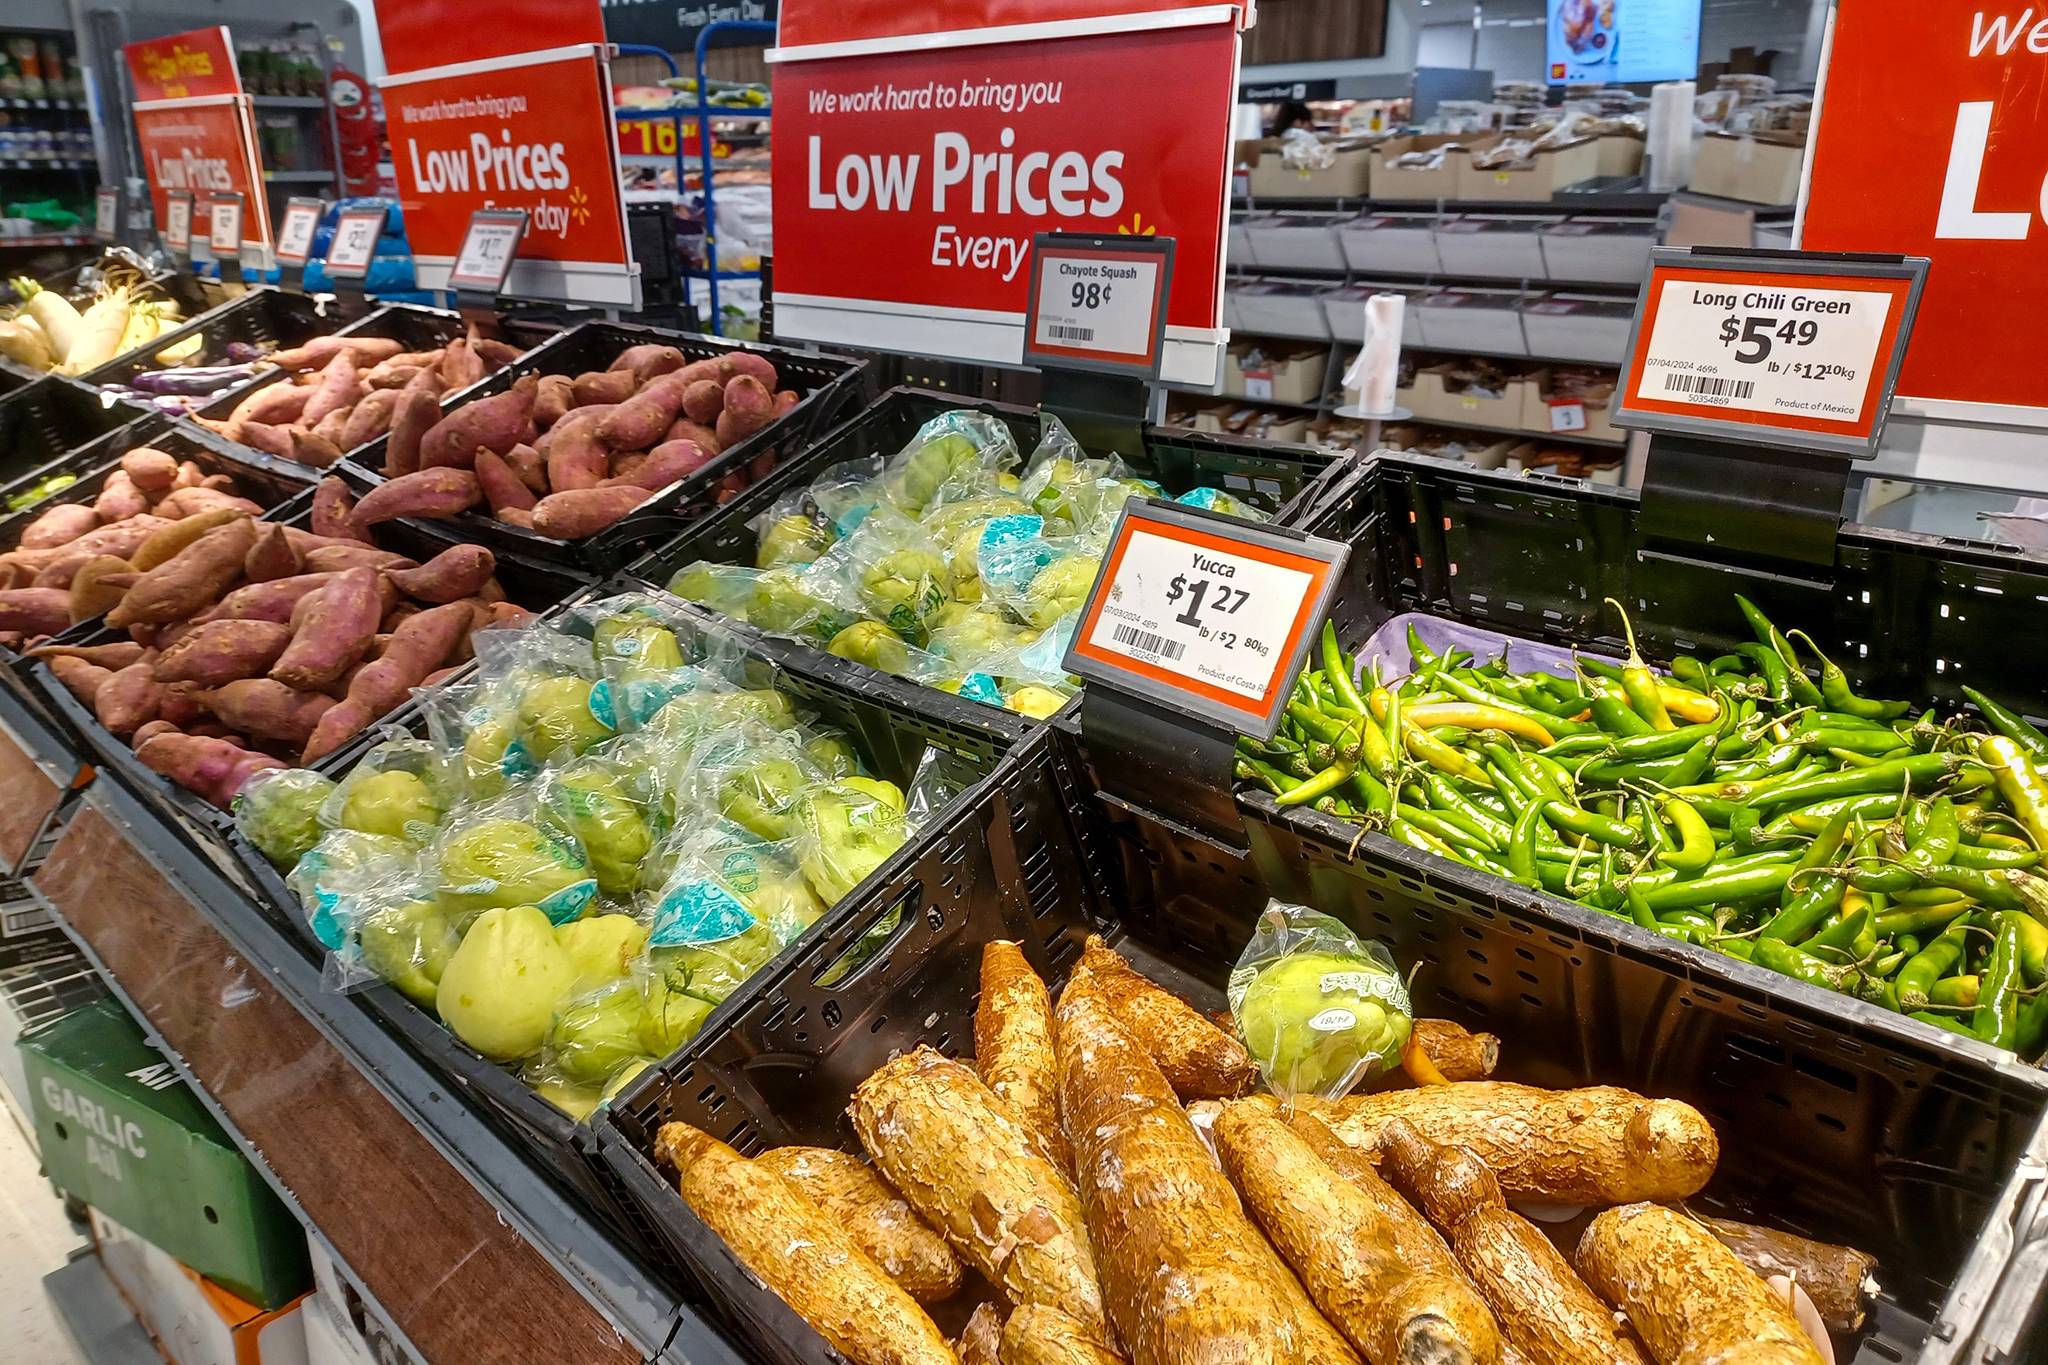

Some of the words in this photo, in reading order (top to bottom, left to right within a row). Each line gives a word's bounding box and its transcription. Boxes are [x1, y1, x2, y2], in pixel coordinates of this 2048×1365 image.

[504, 96, 527, 119] you
[808, 90, 836, 113] We
[839, 89, 883, 112] work
[885, 81, 933, 111] hard
[935, 85, 956, 109] to
[959, 77, 1015, 112] bring
[1016, 80, 1062, 112] you
[408, 138, 469, 193] Low
[470, 128, 570, 191] Prices
[808, 135, 920, 211] Low
[932, 127, 1125, 217] Prices
[534, 198, 569, 239] day
[931, 225, 1029, 282] Every
[1060, 263, 1098, 278] Chayote
[1100, 266, 1137, 280] Squash
[1071, 281, 1112, 309] 98¢
[1692, 290, 1737, 310] Long
[1742, 292, 1786, 311] Chili
[1791, 296, 1851, 315] Green
[1647, 357, 1695, 370] 07/04/2024
[1696, 364, 1718, 375] 4696
[1767, 361, 1780, 374] lb
[1688, 393, 1730, 406] 50354869
[1775, 397, 1809, 411] Product
[1811, 400, 1822, 411] of
[1822, 402, 1855, 415] Mexico
[1192, 553, 1236, 579] Yucca
[1199, 625, 1210, 639] lb
[1198, 664, 1226, 681] Product
[1226, 670, 1236, 683] of
[1235, 676, 1256, 691] Costa
[40, 1076, 146, 1159] GARLIC
[86, 1136, 122, 1182] Ail
